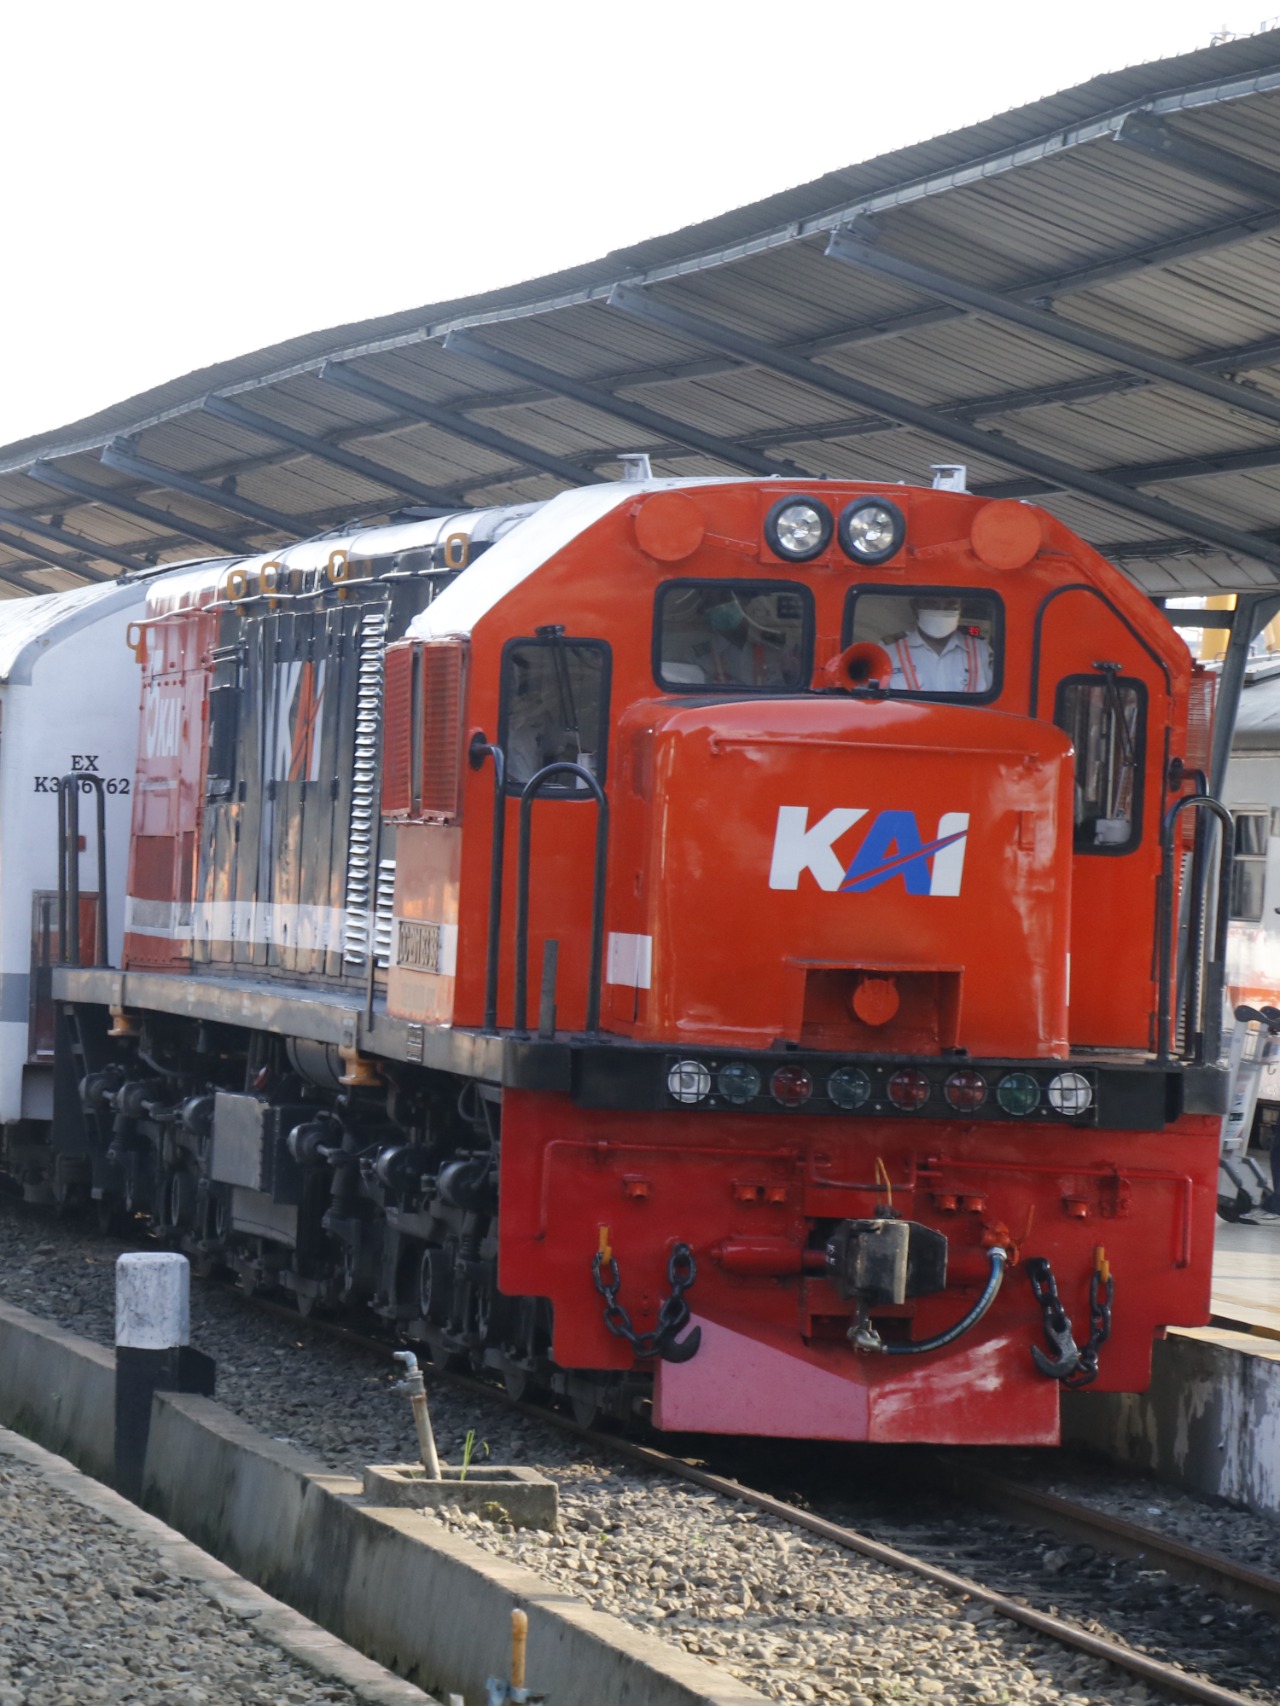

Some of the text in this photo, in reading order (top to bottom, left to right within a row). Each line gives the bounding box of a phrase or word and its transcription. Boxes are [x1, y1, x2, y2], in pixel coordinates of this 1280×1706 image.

[156, 698, 181, 757] KAI
[263, 660, 326, 781] KAI
[34, 777, 130, 794] K3662
[71, 755, 99, 771] EX
[769, 805, 970, 896] KAI
